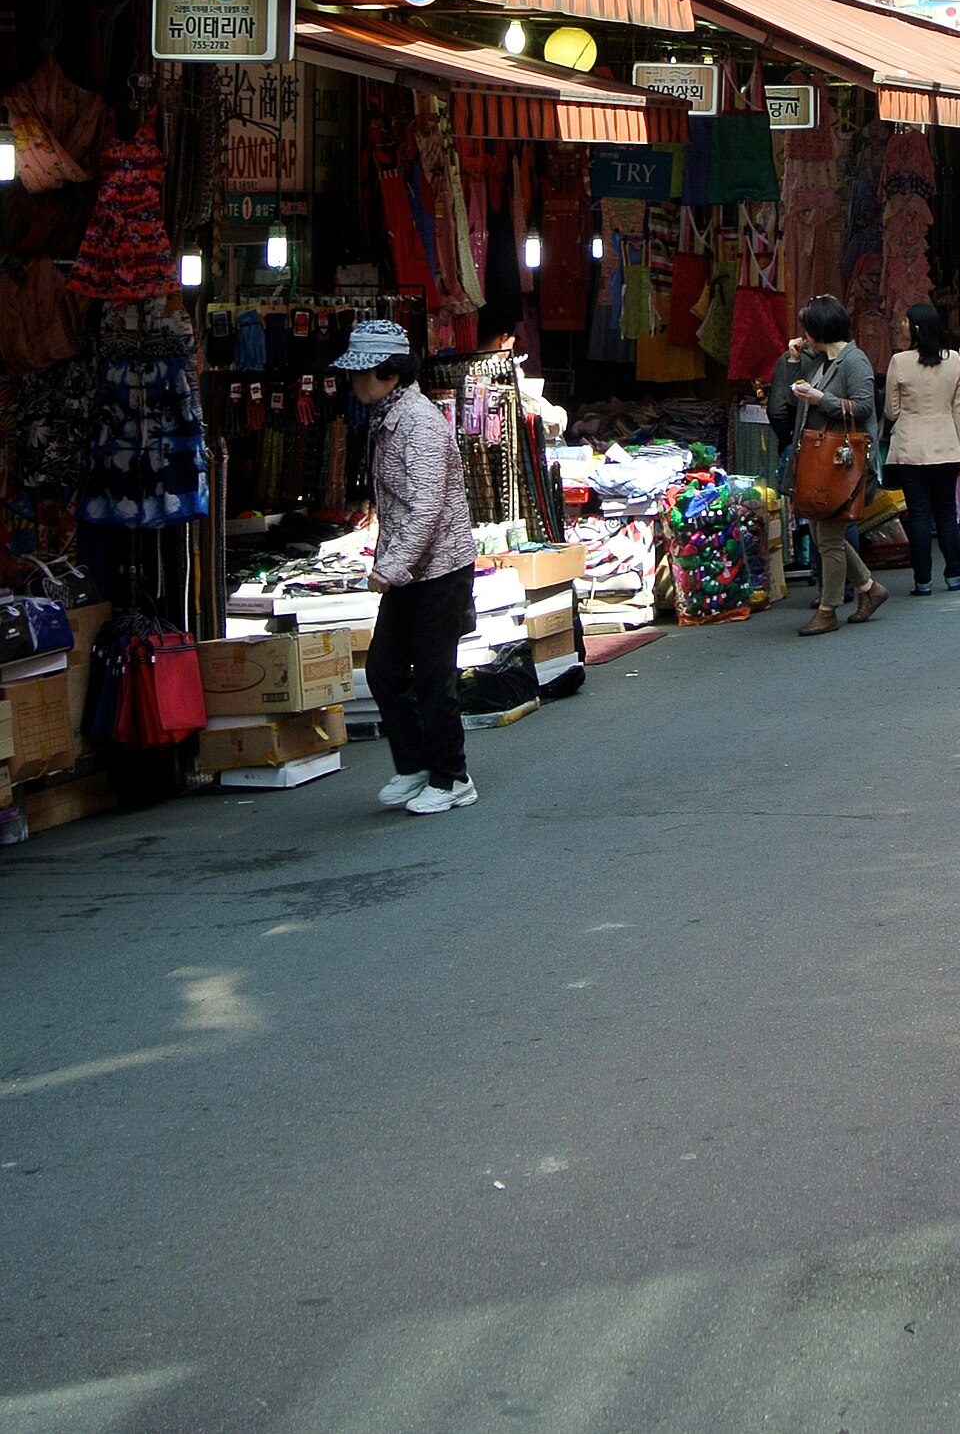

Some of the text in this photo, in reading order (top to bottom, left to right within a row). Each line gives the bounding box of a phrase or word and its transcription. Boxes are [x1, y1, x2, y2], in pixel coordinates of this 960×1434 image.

[169, 16, 255, 39] 뉴이태리사
[192, 40, 230, 50] 755-2782
[610, 161, 657, 183] TRY
